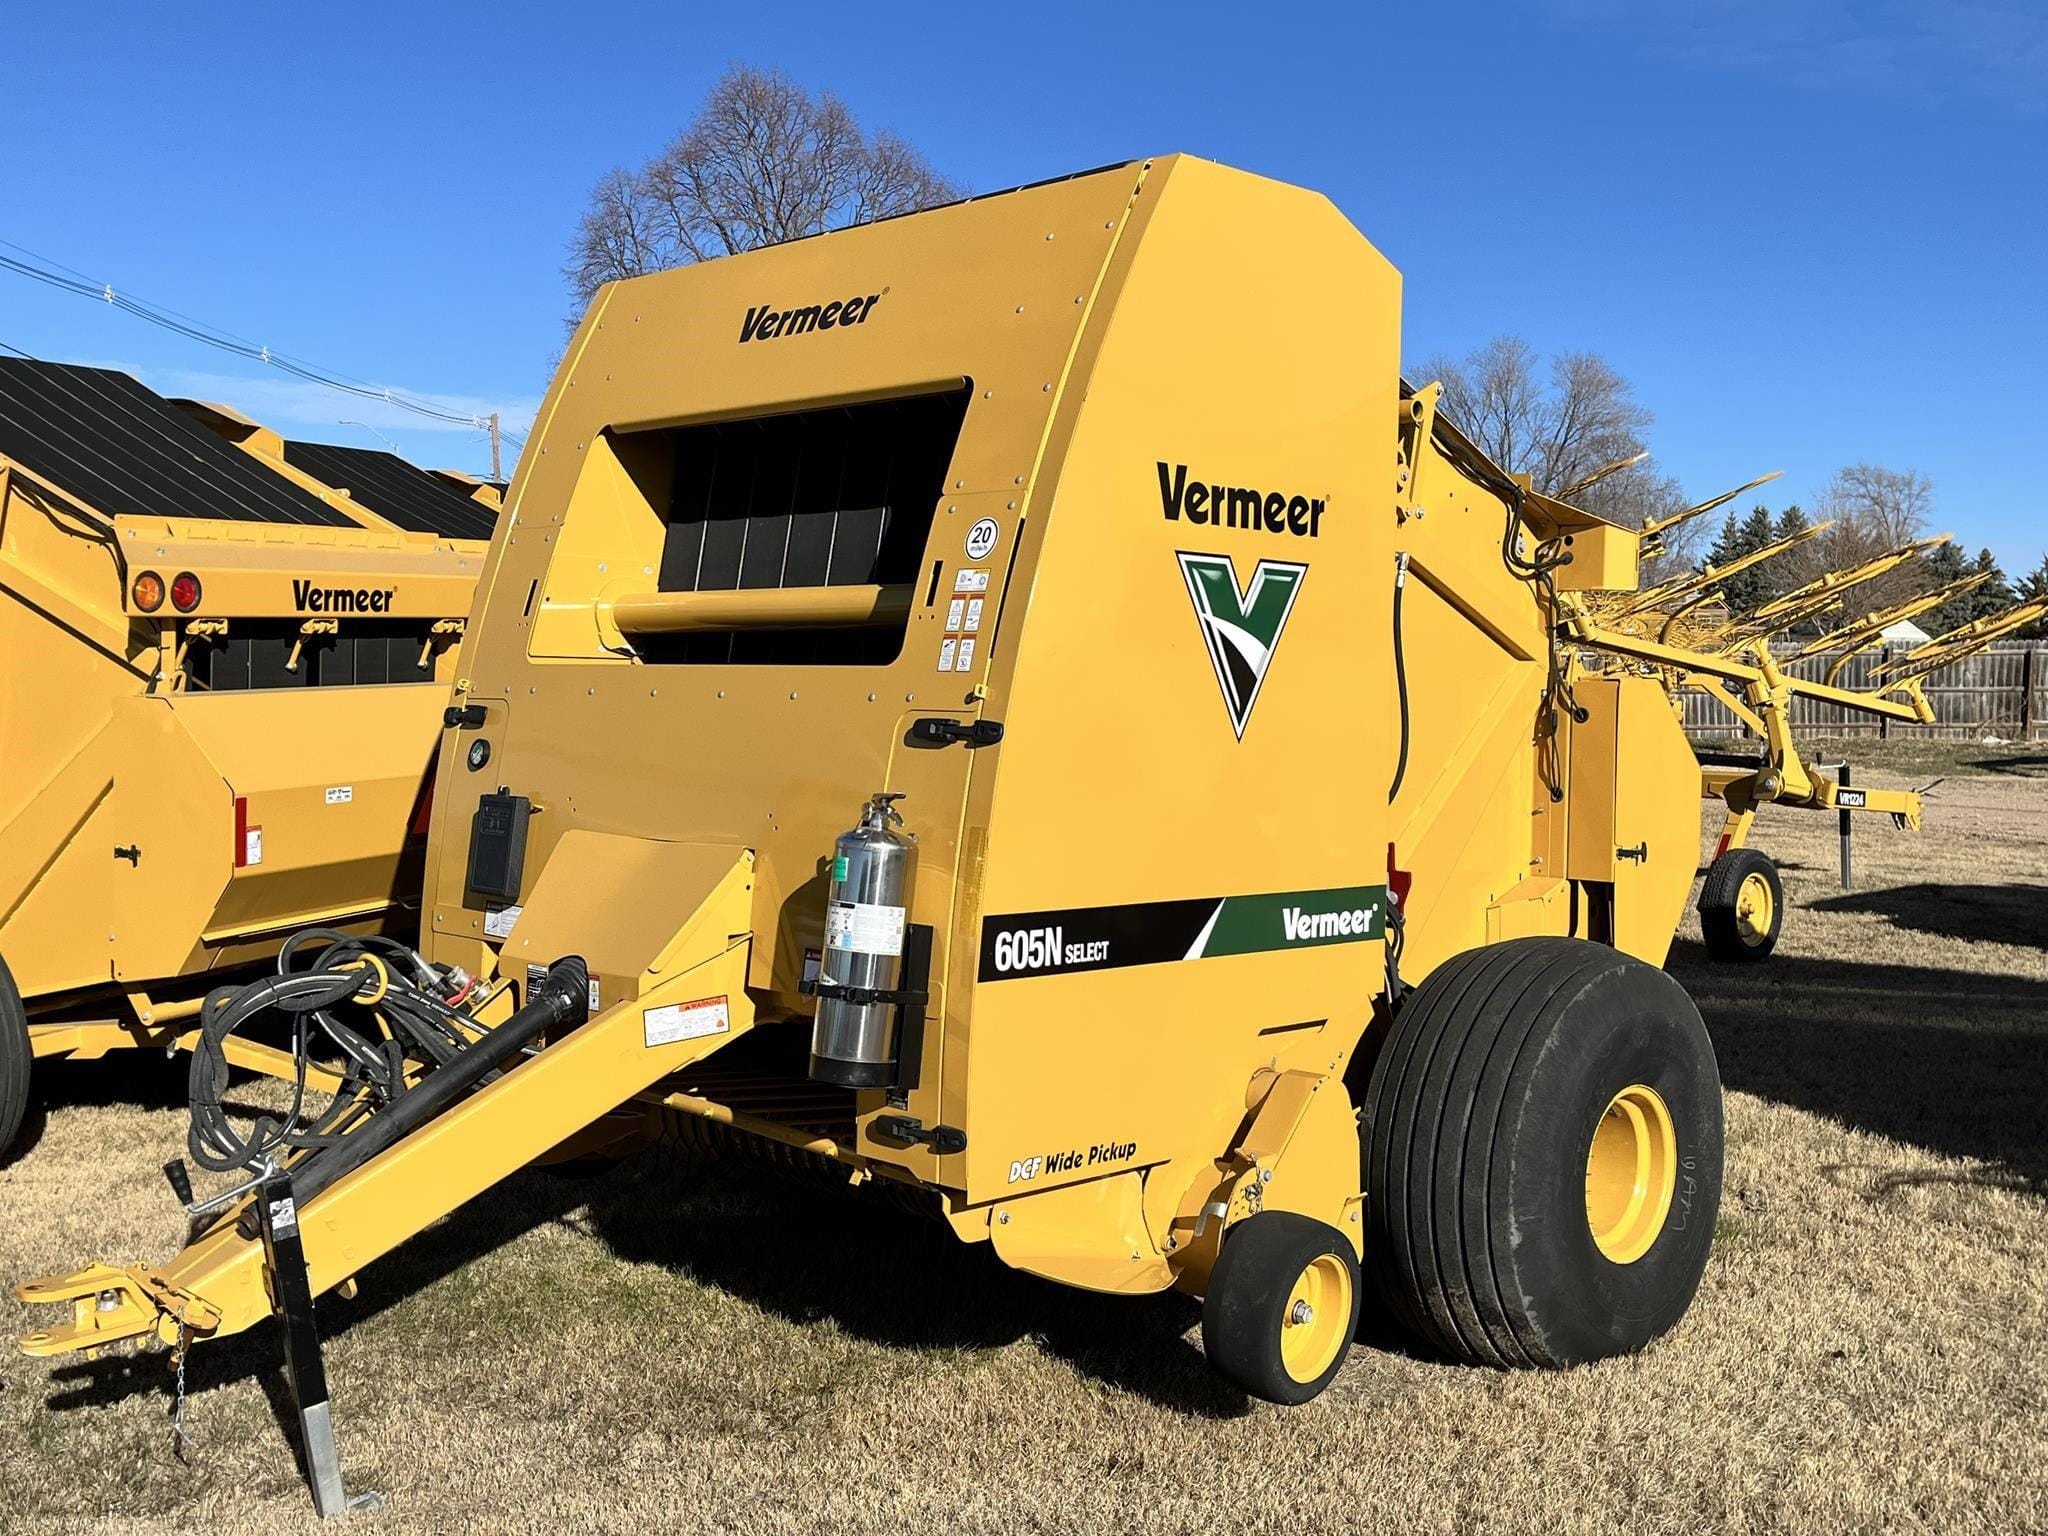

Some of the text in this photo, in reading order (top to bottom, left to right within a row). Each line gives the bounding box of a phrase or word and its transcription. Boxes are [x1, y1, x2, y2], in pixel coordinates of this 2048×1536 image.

[971, 526, 992, 544] 20
[1839, 792, 1864, 805] VR1224
[994, 926, 1110, 972] 605N SELECT
[1008, 1142, 1137, 1184] DCF Wide Pickup
